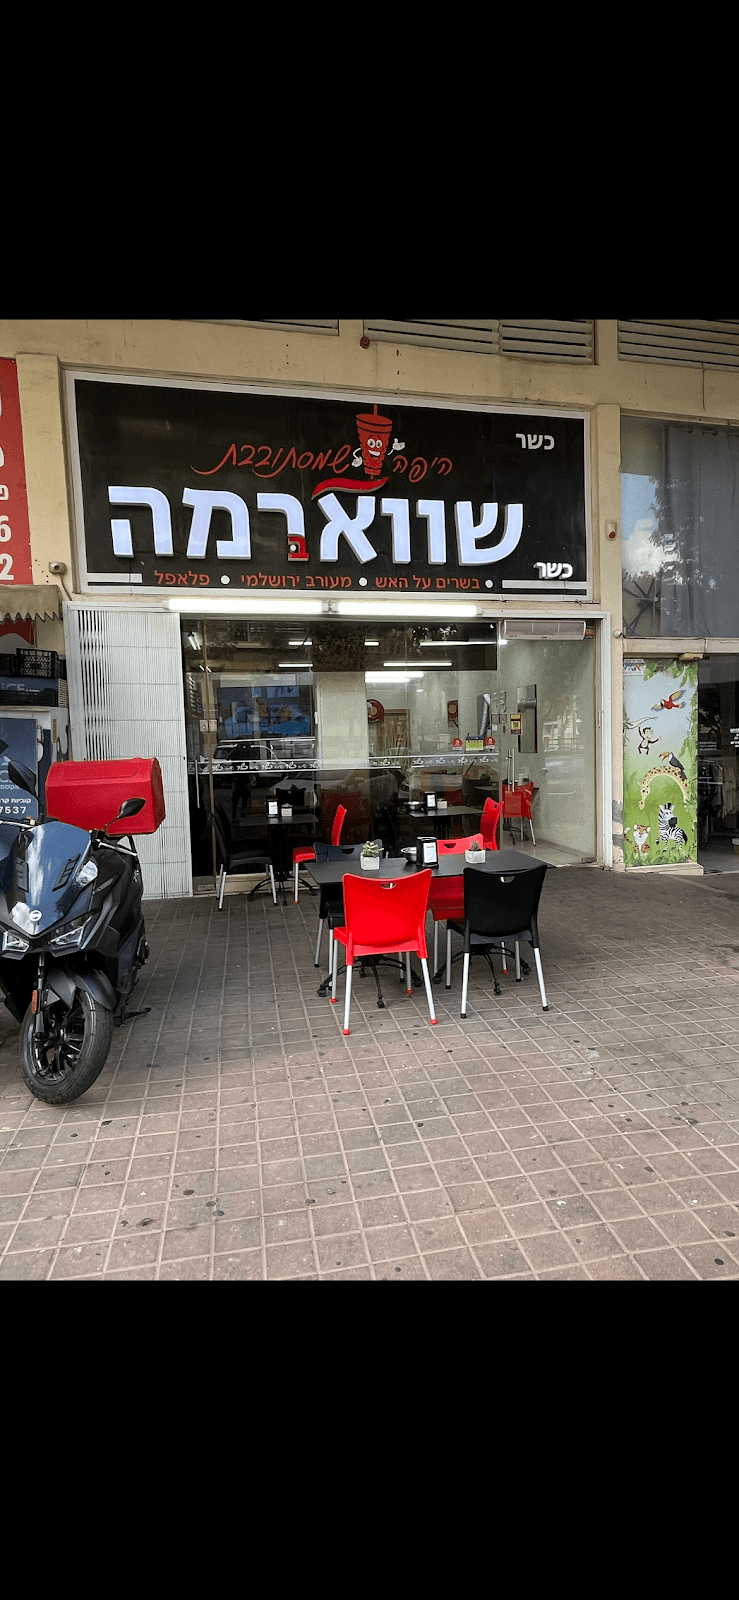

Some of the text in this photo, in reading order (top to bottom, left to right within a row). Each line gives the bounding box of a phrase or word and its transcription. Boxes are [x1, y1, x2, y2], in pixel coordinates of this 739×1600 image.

[515, 433, 555, 450] כשר
[190, 443, 453, 483] היפה שמסתובבת
[108, 485, 523, 566] שווארמה
[154, 570, 211, 585] פלאפל
[533, 562, 574, 579] כשר
[241, 572, 352, 589] מעורב ירושלמי
[375, 574, 480, 589] בשרים על האש
